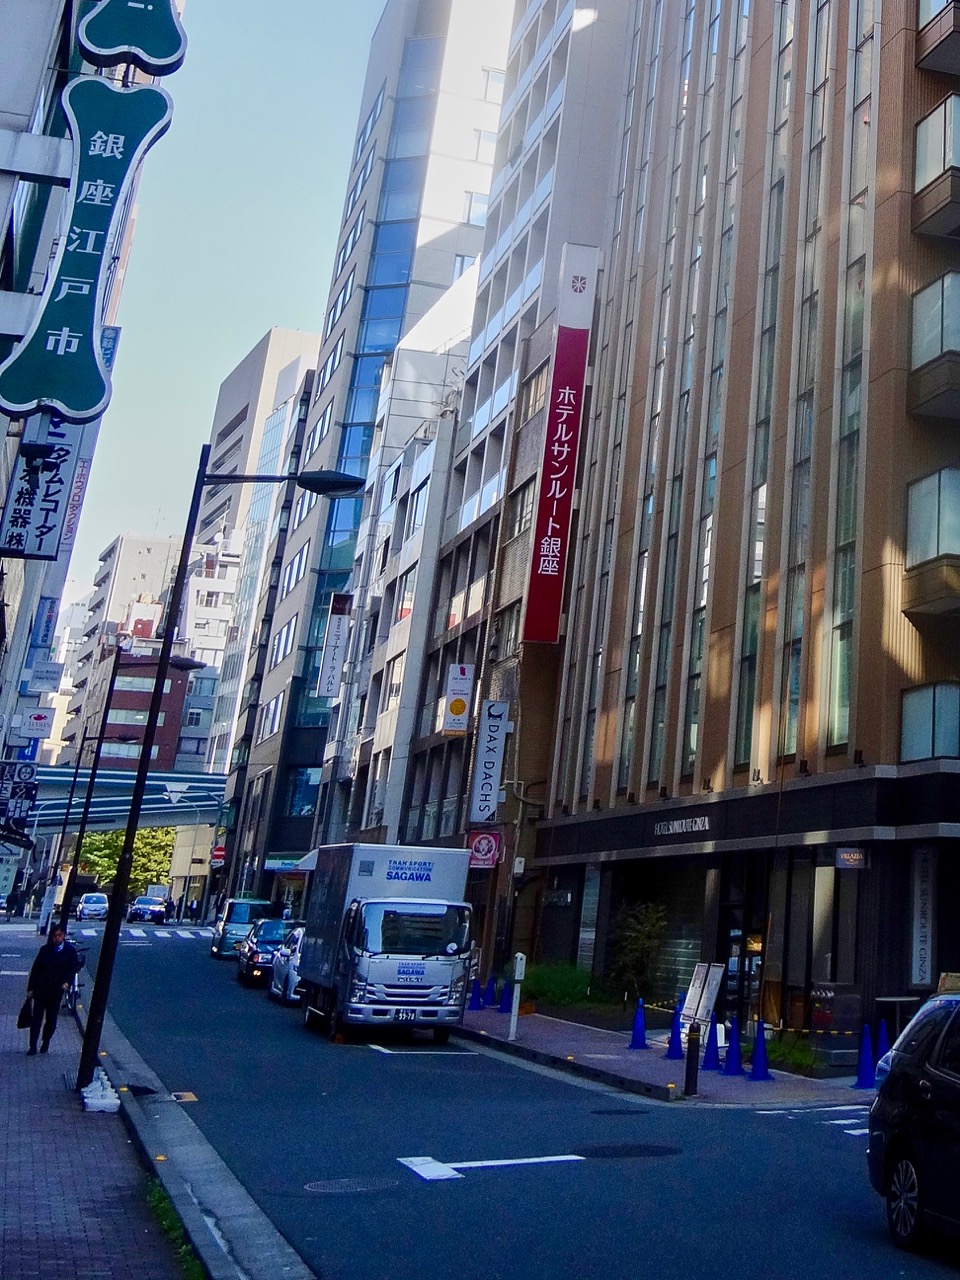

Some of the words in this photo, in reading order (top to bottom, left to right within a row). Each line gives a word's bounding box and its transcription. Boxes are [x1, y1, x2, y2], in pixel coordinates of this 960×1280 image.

[45, 130, 126, 356] 銀座江戸市
[537, 385, 577, 576] ホテルサンルート銀座
[485, 724, 500, 754] DAX
[478, 761, 495, 813] DACHS
[386, 871, 431, 882] SAGAWA
[918, 948, 928, 982] GINZA
